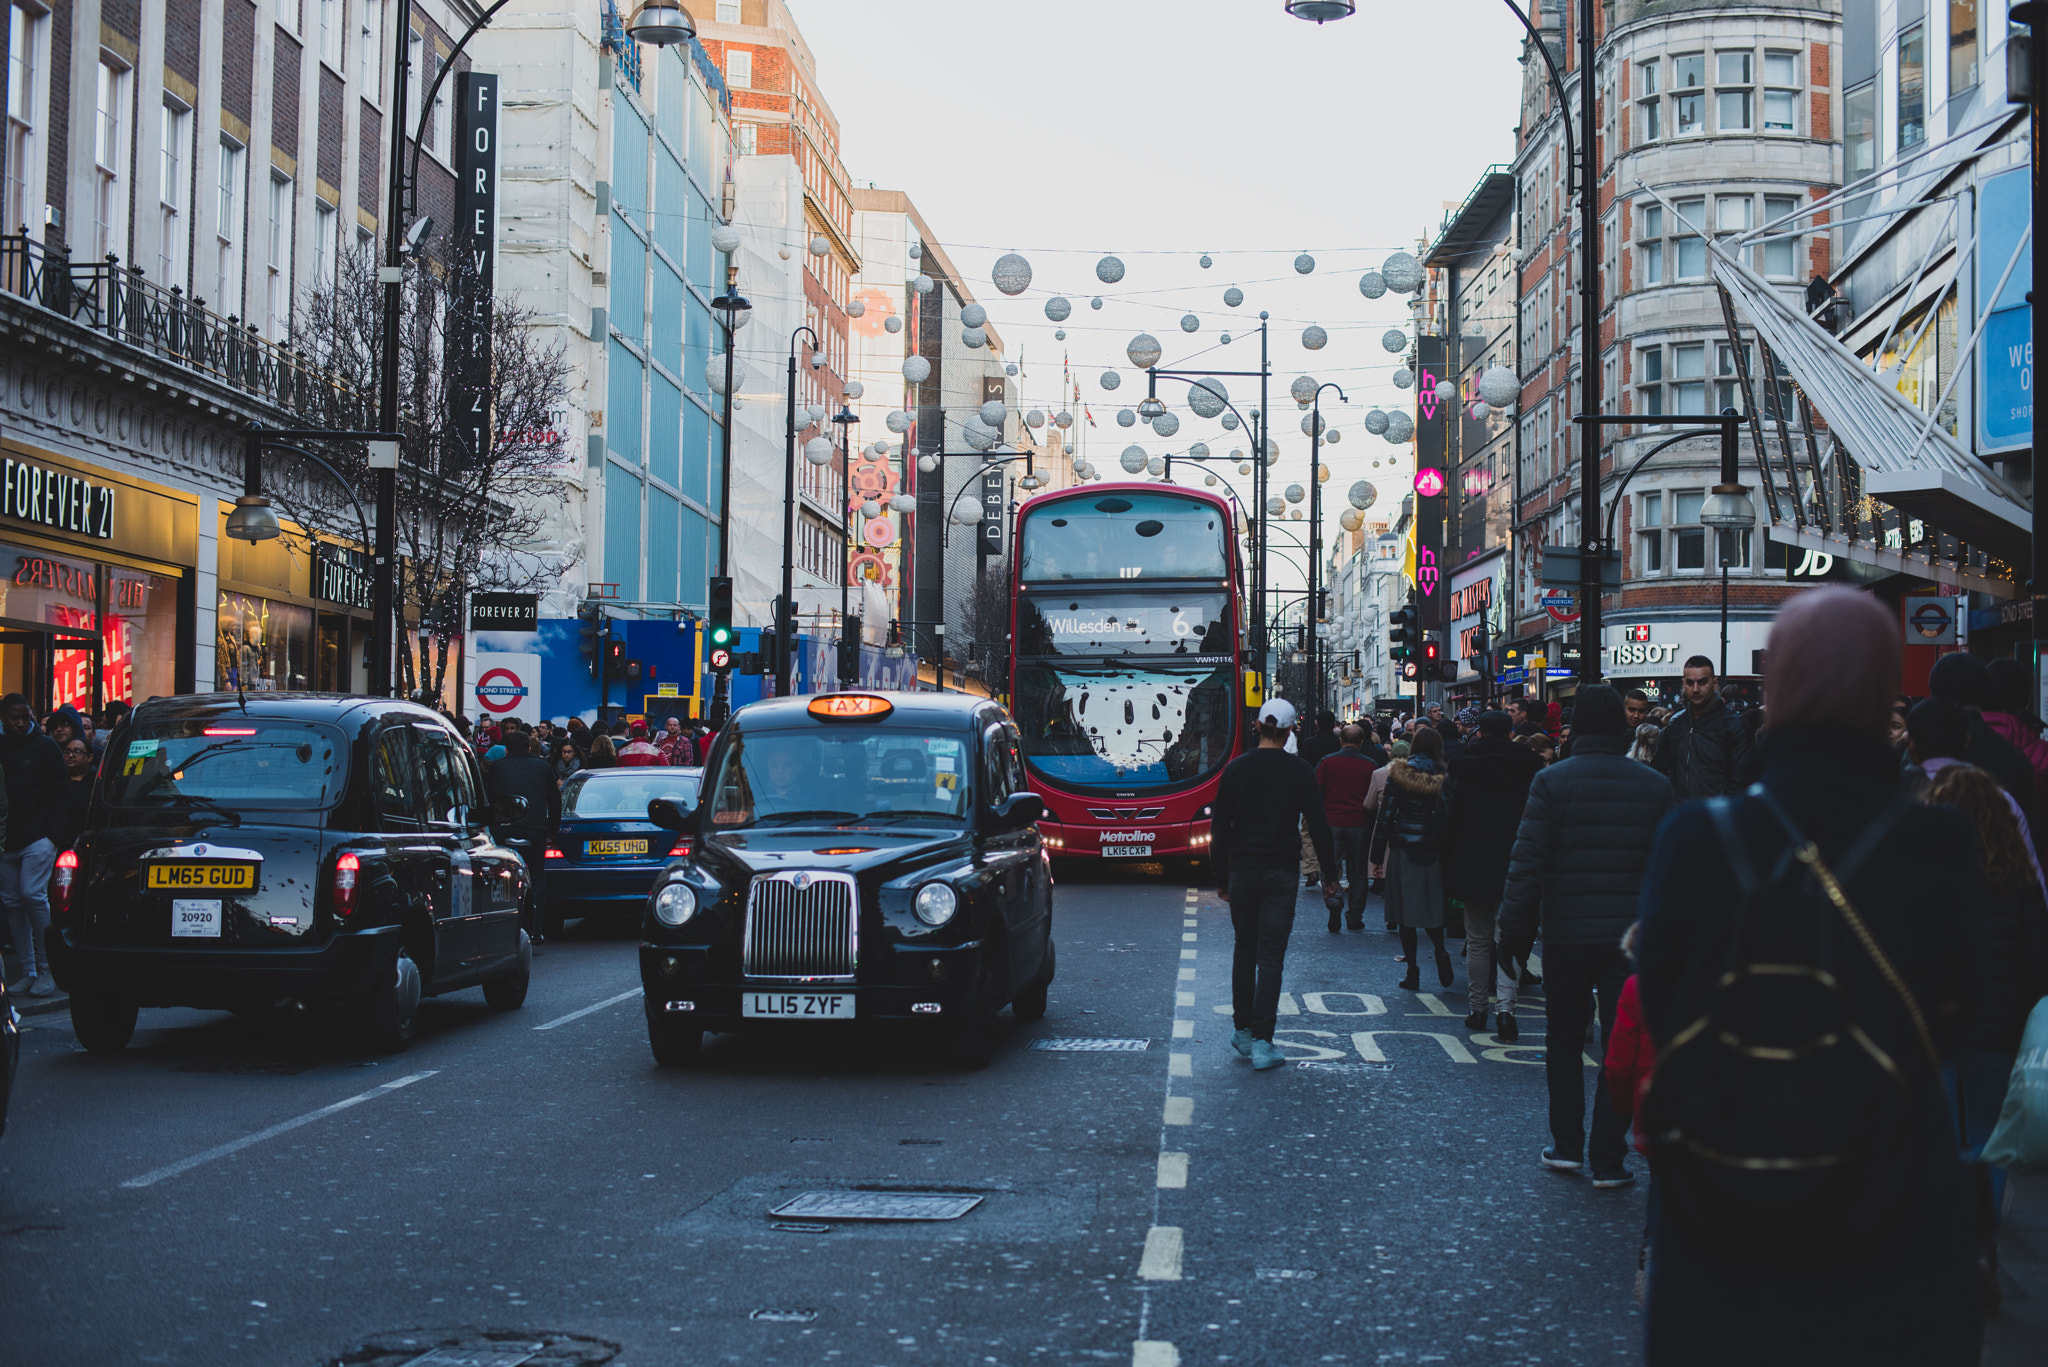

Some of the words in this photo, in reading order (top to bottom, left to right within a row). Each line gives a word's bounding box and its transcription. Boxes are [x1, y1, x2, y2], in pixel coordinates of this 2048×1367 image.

[2009, 342, 2033, 368] we
[1419, 368, 1440, 421] hmv
[2011, 404, 2033, 420] SHOP
[3, 458, 92, 534] FOREVER
[98, 486, 116, 540] 21
[1418, 544, 1439, 597] hmv
[1793, 549, 1833, 577] JD
[473, 606, 520, 618] FOREVER
[524, 606, 535, 618] 21
[1450, 591, 1461, 622] HIS
[2018, 600, 2033, 620] STREE
[1049, 616, 1121, 635] Willesden
[1172, 610, 1190, 637] 6
[102, 621, 133, 667] ALE
[1460, 625, 1481, 660] VOI
[1609, 643, 1680, 665] TISSOT
[53, 660, 88, 710] ALE
[479, 686, 498, 694] BOND
[499, 686, 521, 695] STREET
[825, 700, 872, 712] TAXI
[1099, 830, 1156, 842] Metroline
[590, 841, 621, 853] KU55
[1107, 847, 1127, 856] LK15
[1129, 846, 1147, 855] CXR
[156, 867, 205, 885] LM65
[209, 867, 246, 885] GUD
[181, 912, 213, 923] 20920
[754, 995, 798, 1014] LL15
[803, 995, 843, 1015] ZYF
